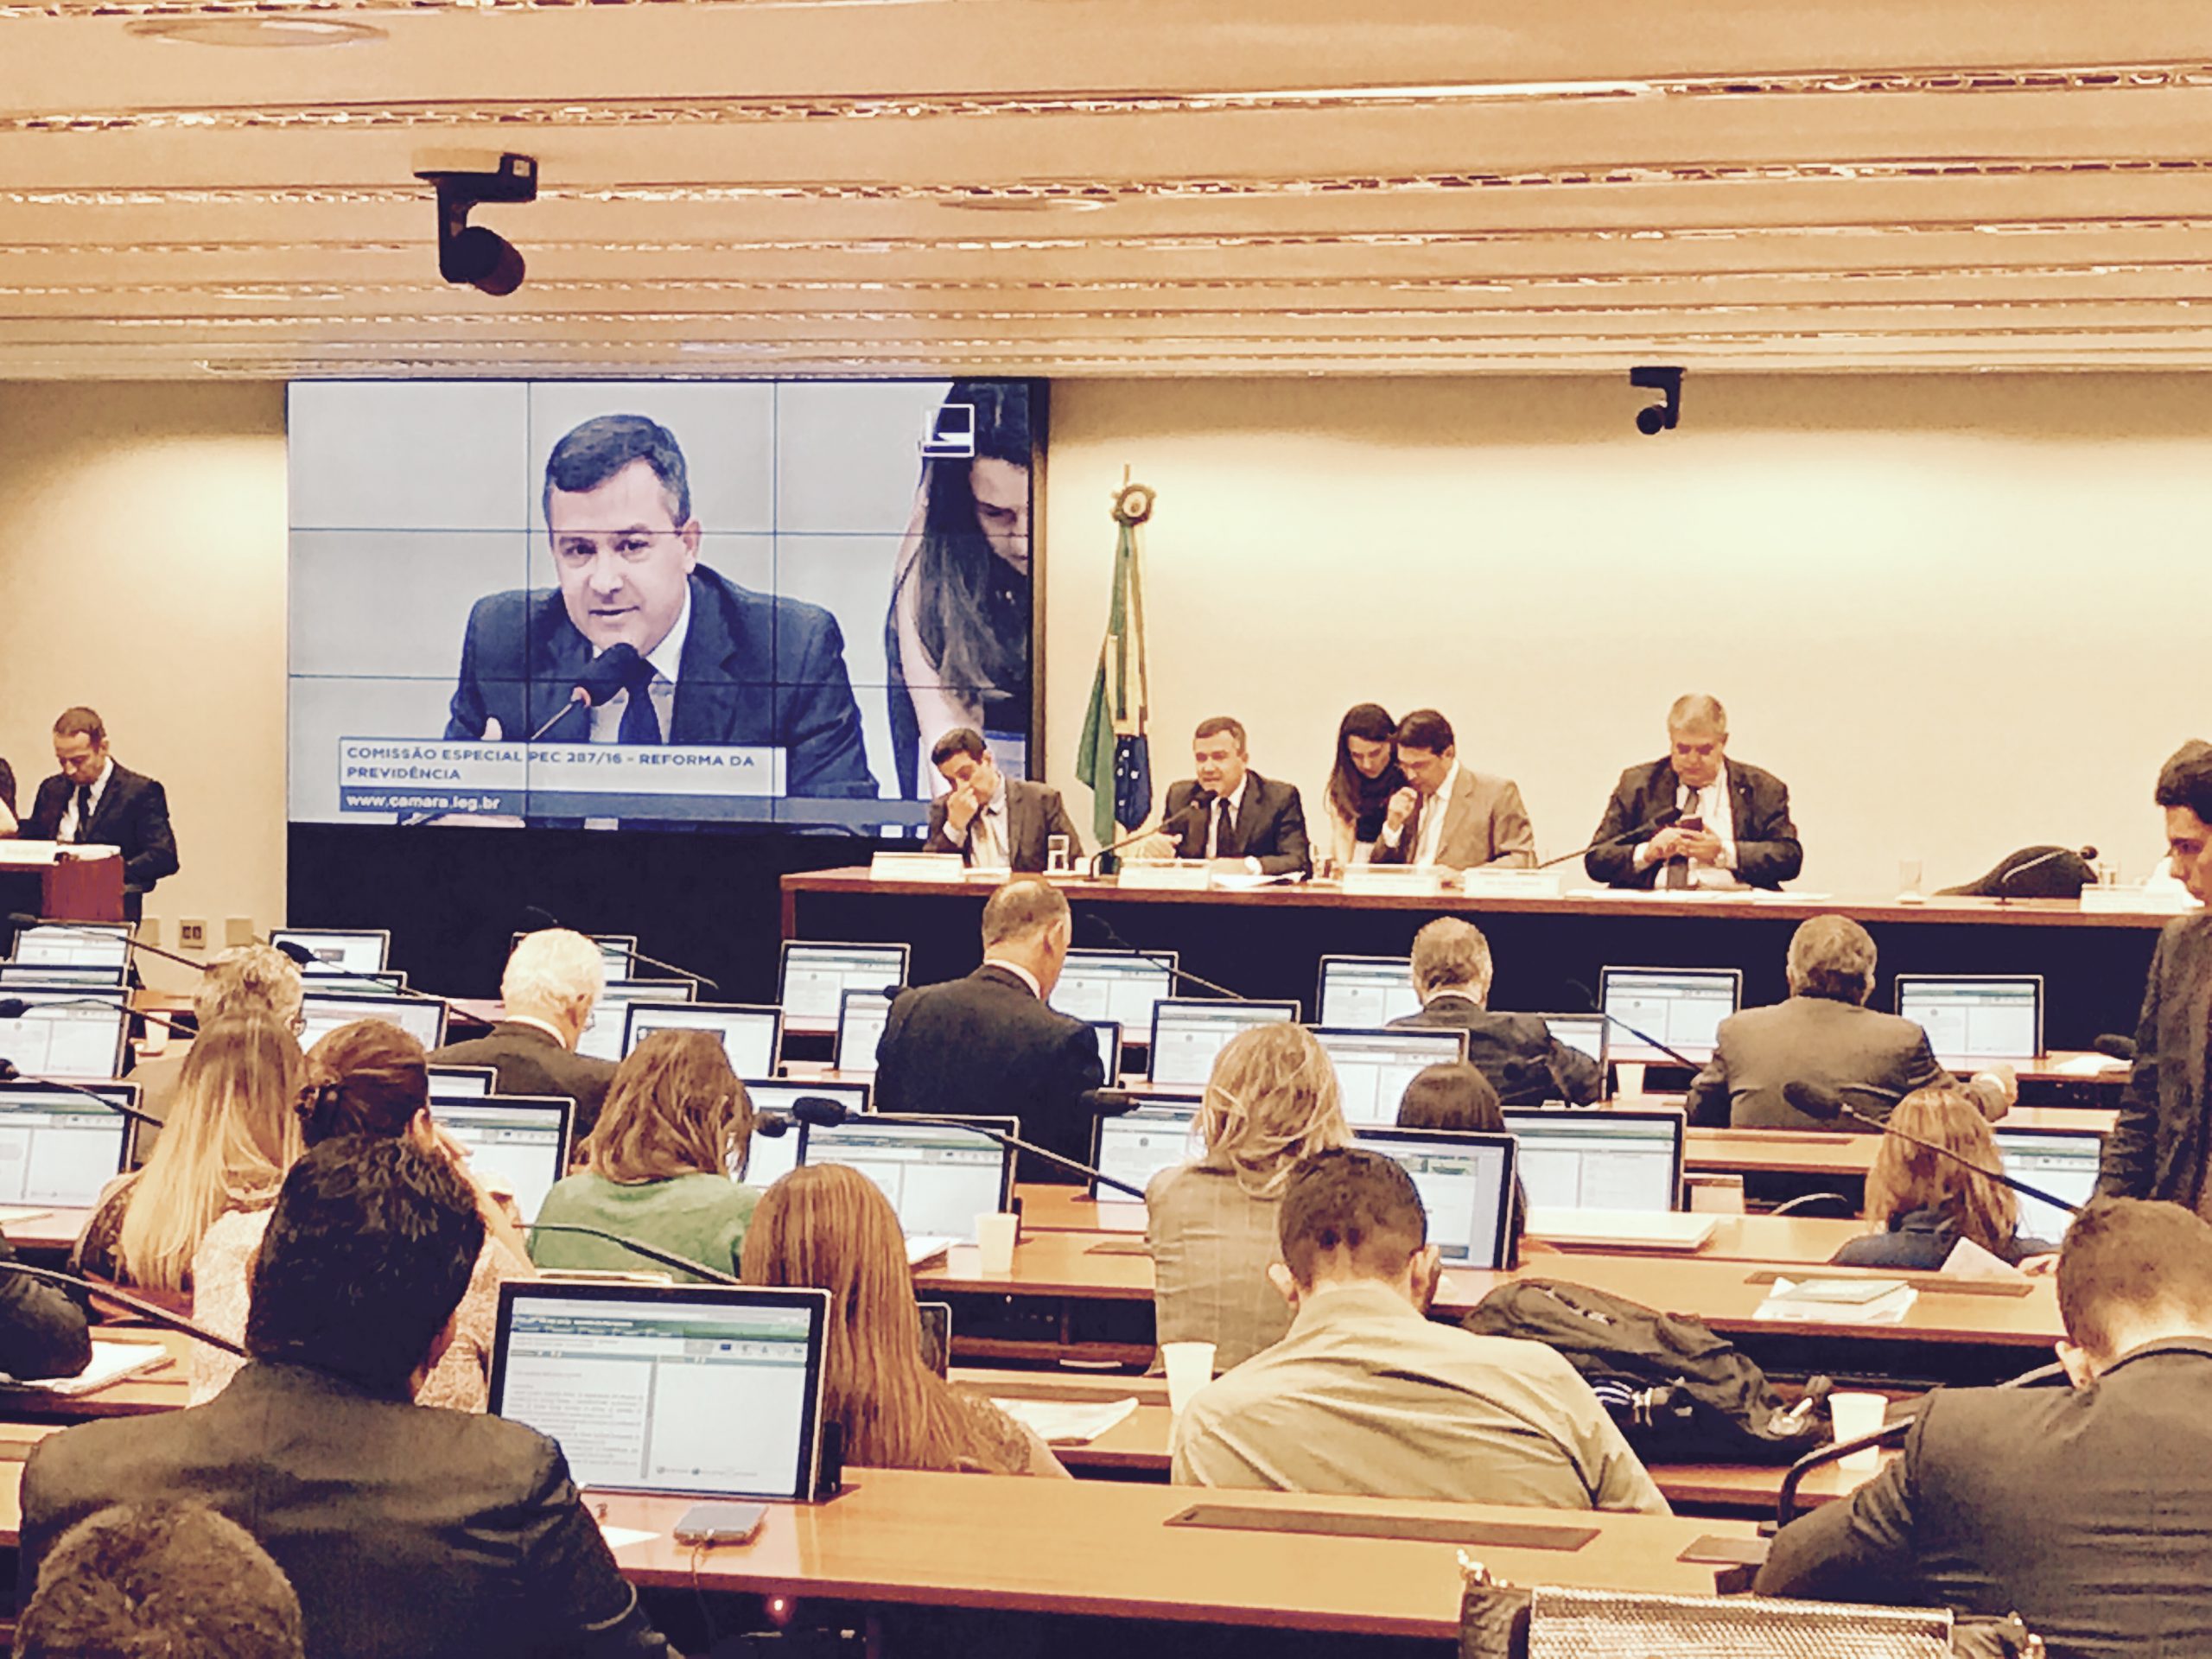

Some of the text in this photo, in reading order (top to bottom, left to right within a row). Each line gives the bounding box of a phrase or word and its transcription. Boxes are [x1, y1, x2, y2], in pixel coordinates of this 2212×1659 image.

[346, 747, 436, 760] COMISSÃO
[442, 749, 523, 761] ESPECIAL
[528, 752, 561, 762] PEC
[567, 751, 621, 764] 287/16
[639, 753, 724, 766] REFORMA
[730, 755, 754, 766] DA
[346, 766, 461, 779] PREVIDÊNCIA
[346, 795, 500, 811] www.camara.leg.br
